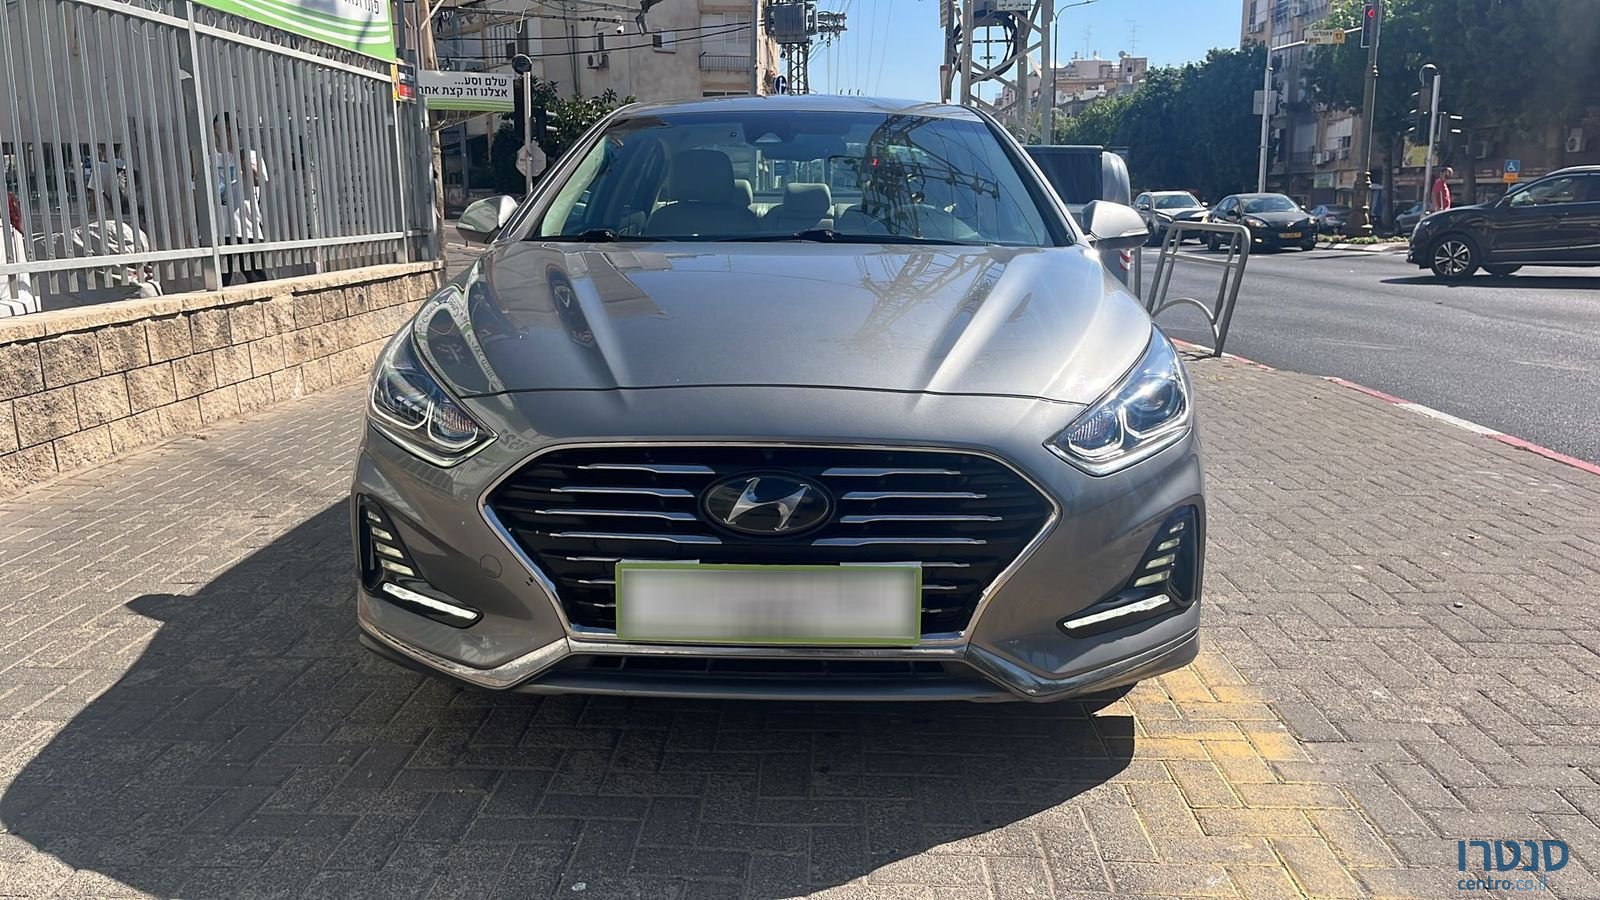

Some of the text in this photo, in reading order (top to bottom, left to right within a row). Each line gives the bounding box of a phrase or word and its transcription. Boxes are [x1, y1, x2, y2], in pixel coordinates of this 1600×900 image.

[454, 76, 507, 87] שלם וסע...
[419, 86, 508, 98] אצלנו זה קצת אחר
